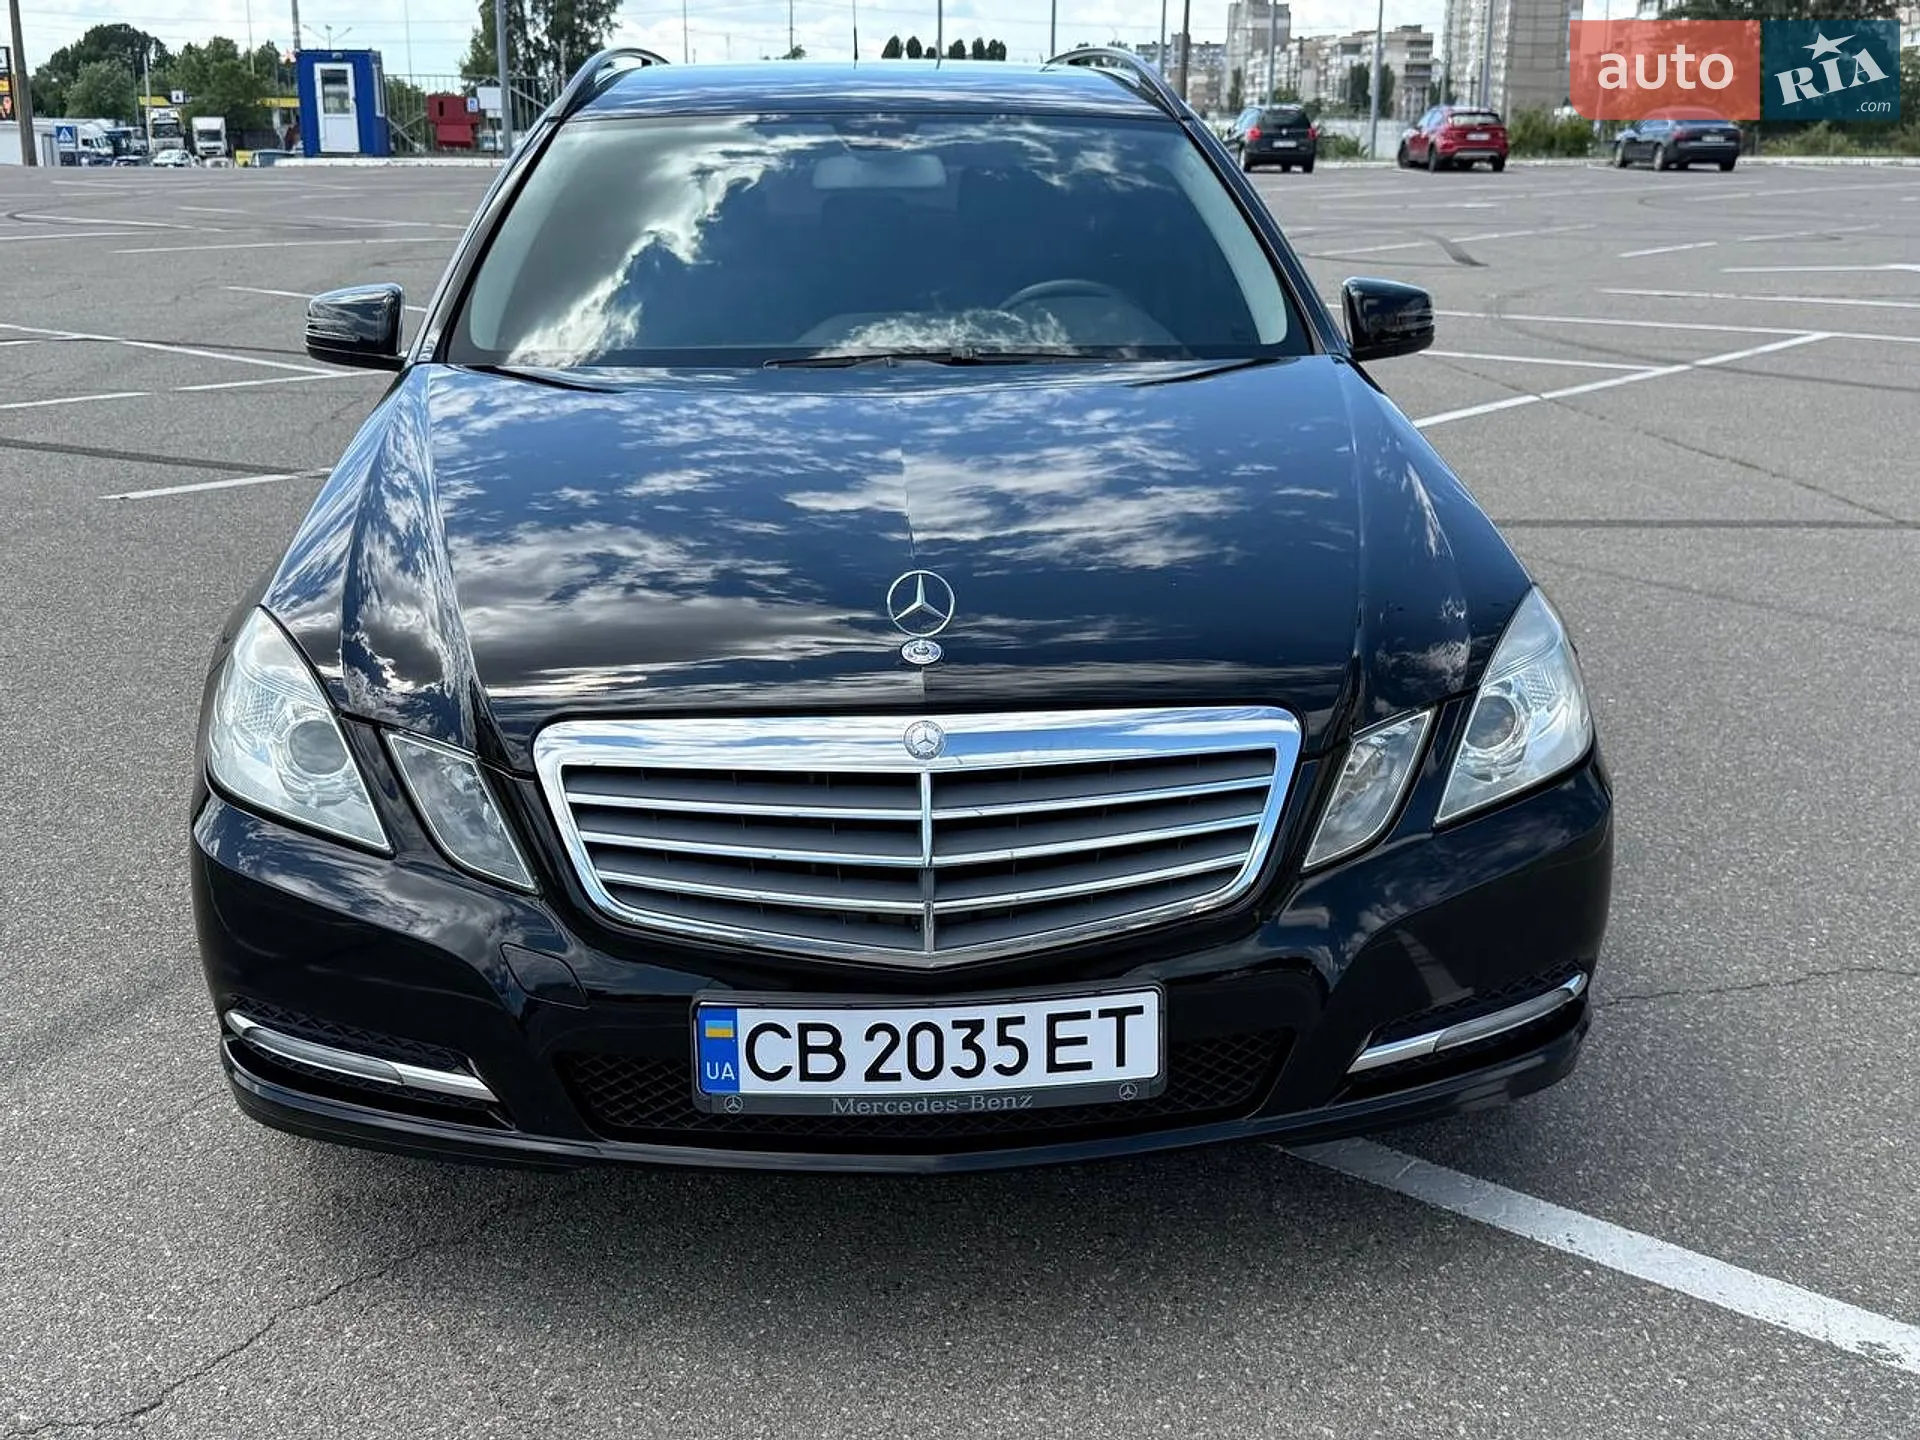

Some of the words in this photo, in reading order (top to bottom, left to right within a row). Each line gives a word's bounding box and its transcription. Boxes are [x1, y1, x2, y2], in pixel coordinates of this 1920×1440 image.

[744, 1021, 847, 1082] CB
[863, 1015, 1029, 1082] 2035
[1045, 1005, 1145, 1074] ET
[706, 1061, 736, 1081] UA
[831, 1093, 1034, 1115] Mercedes-Benz
